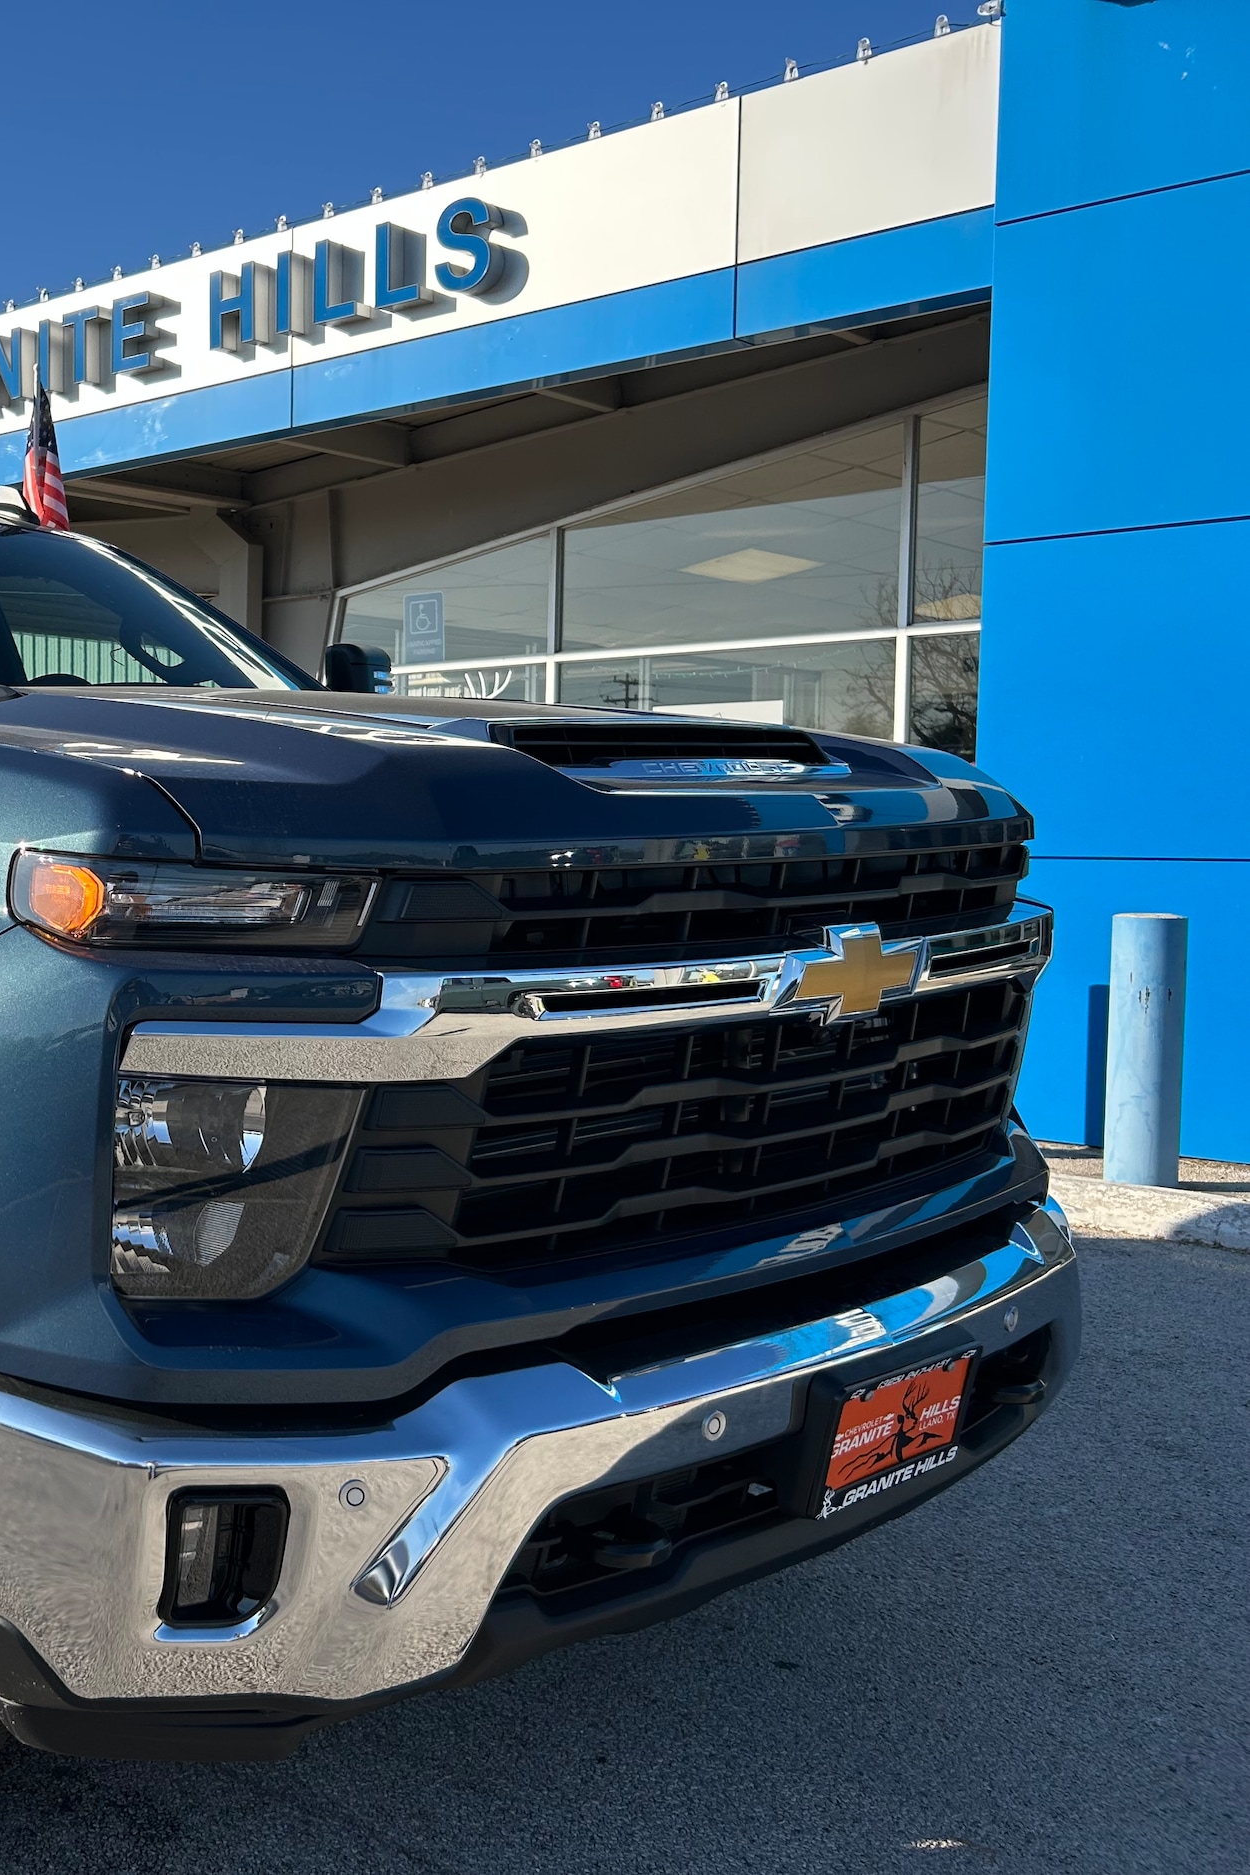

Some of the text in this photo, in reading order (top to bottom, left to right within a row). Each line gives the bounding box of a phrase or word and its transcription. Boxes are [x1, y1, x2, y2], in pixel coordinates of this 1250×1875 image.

[208, 196, 498, 352] HILLS
[919, 1395, 962, 1421] HILLS
[946, 1411, 956, 1421] TX
[831, 1420, 895, 1459] GRANITE
[845, 1416, 884, 1438] CHEVROLET
[842, 1445, 958, 1508] GRANITE HILLS
